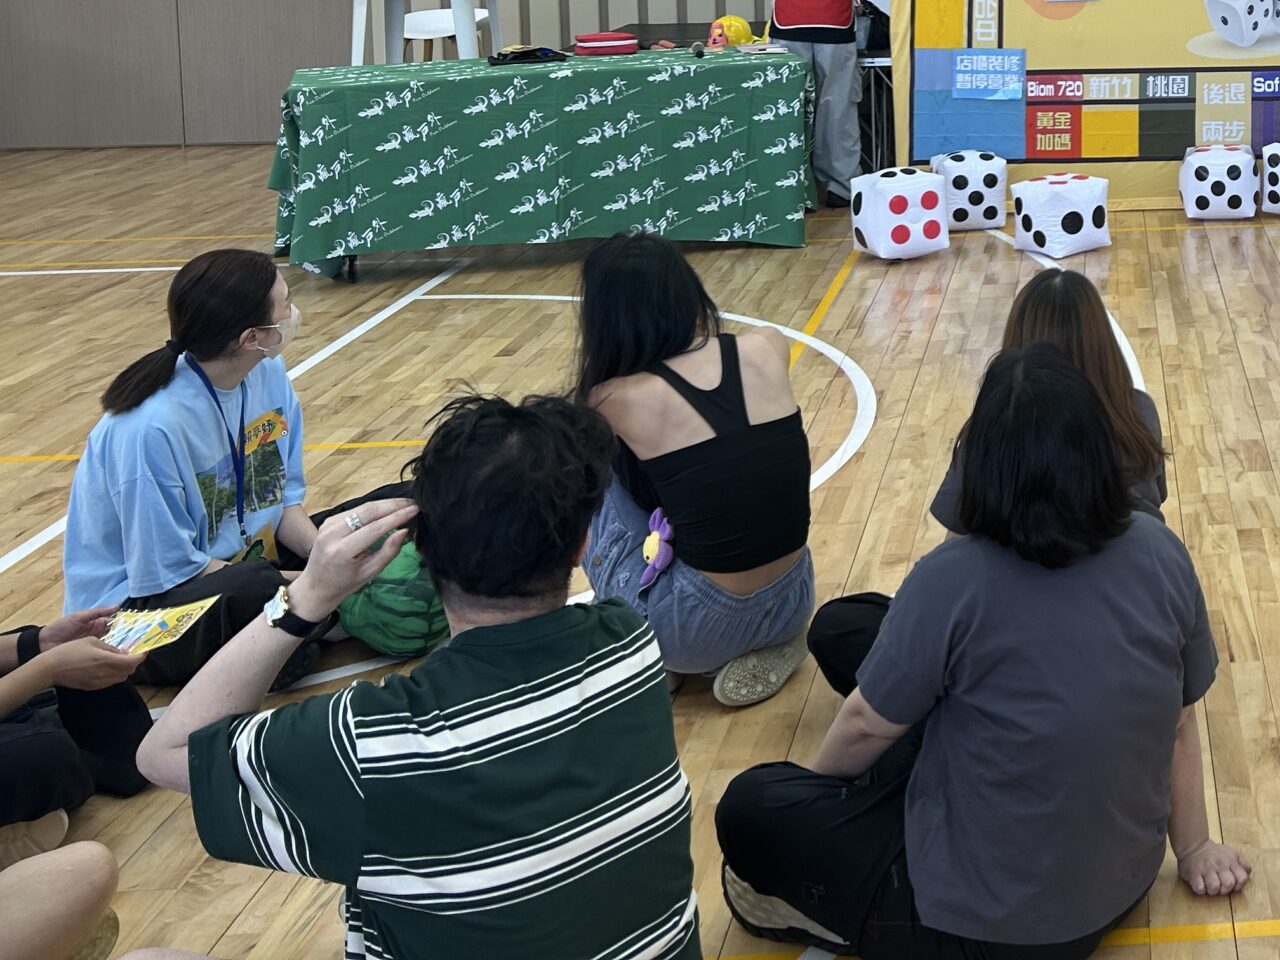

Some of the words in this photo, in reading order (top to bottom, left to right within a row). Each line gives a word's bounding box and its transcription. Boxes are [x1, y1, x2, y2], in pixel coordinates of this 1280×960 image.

[956, 55, 1020, 71] 店櫃裝修
[955, 73, 1021, 90] 暫停營業
[1027, 81, 1055, 97] Biom
[1057, 81, 1083, 96] 720
[1089, 76, 1132, 98] 新竹
[1146, 75, 1189, 97] 桃園
[1203, 82, 1245, 105] 後退
[1036, 111, 1072, 129] 黃金
[1202, 120, 1245, 142] 兩步
[1036, 133, 1072, 151] 加碼
